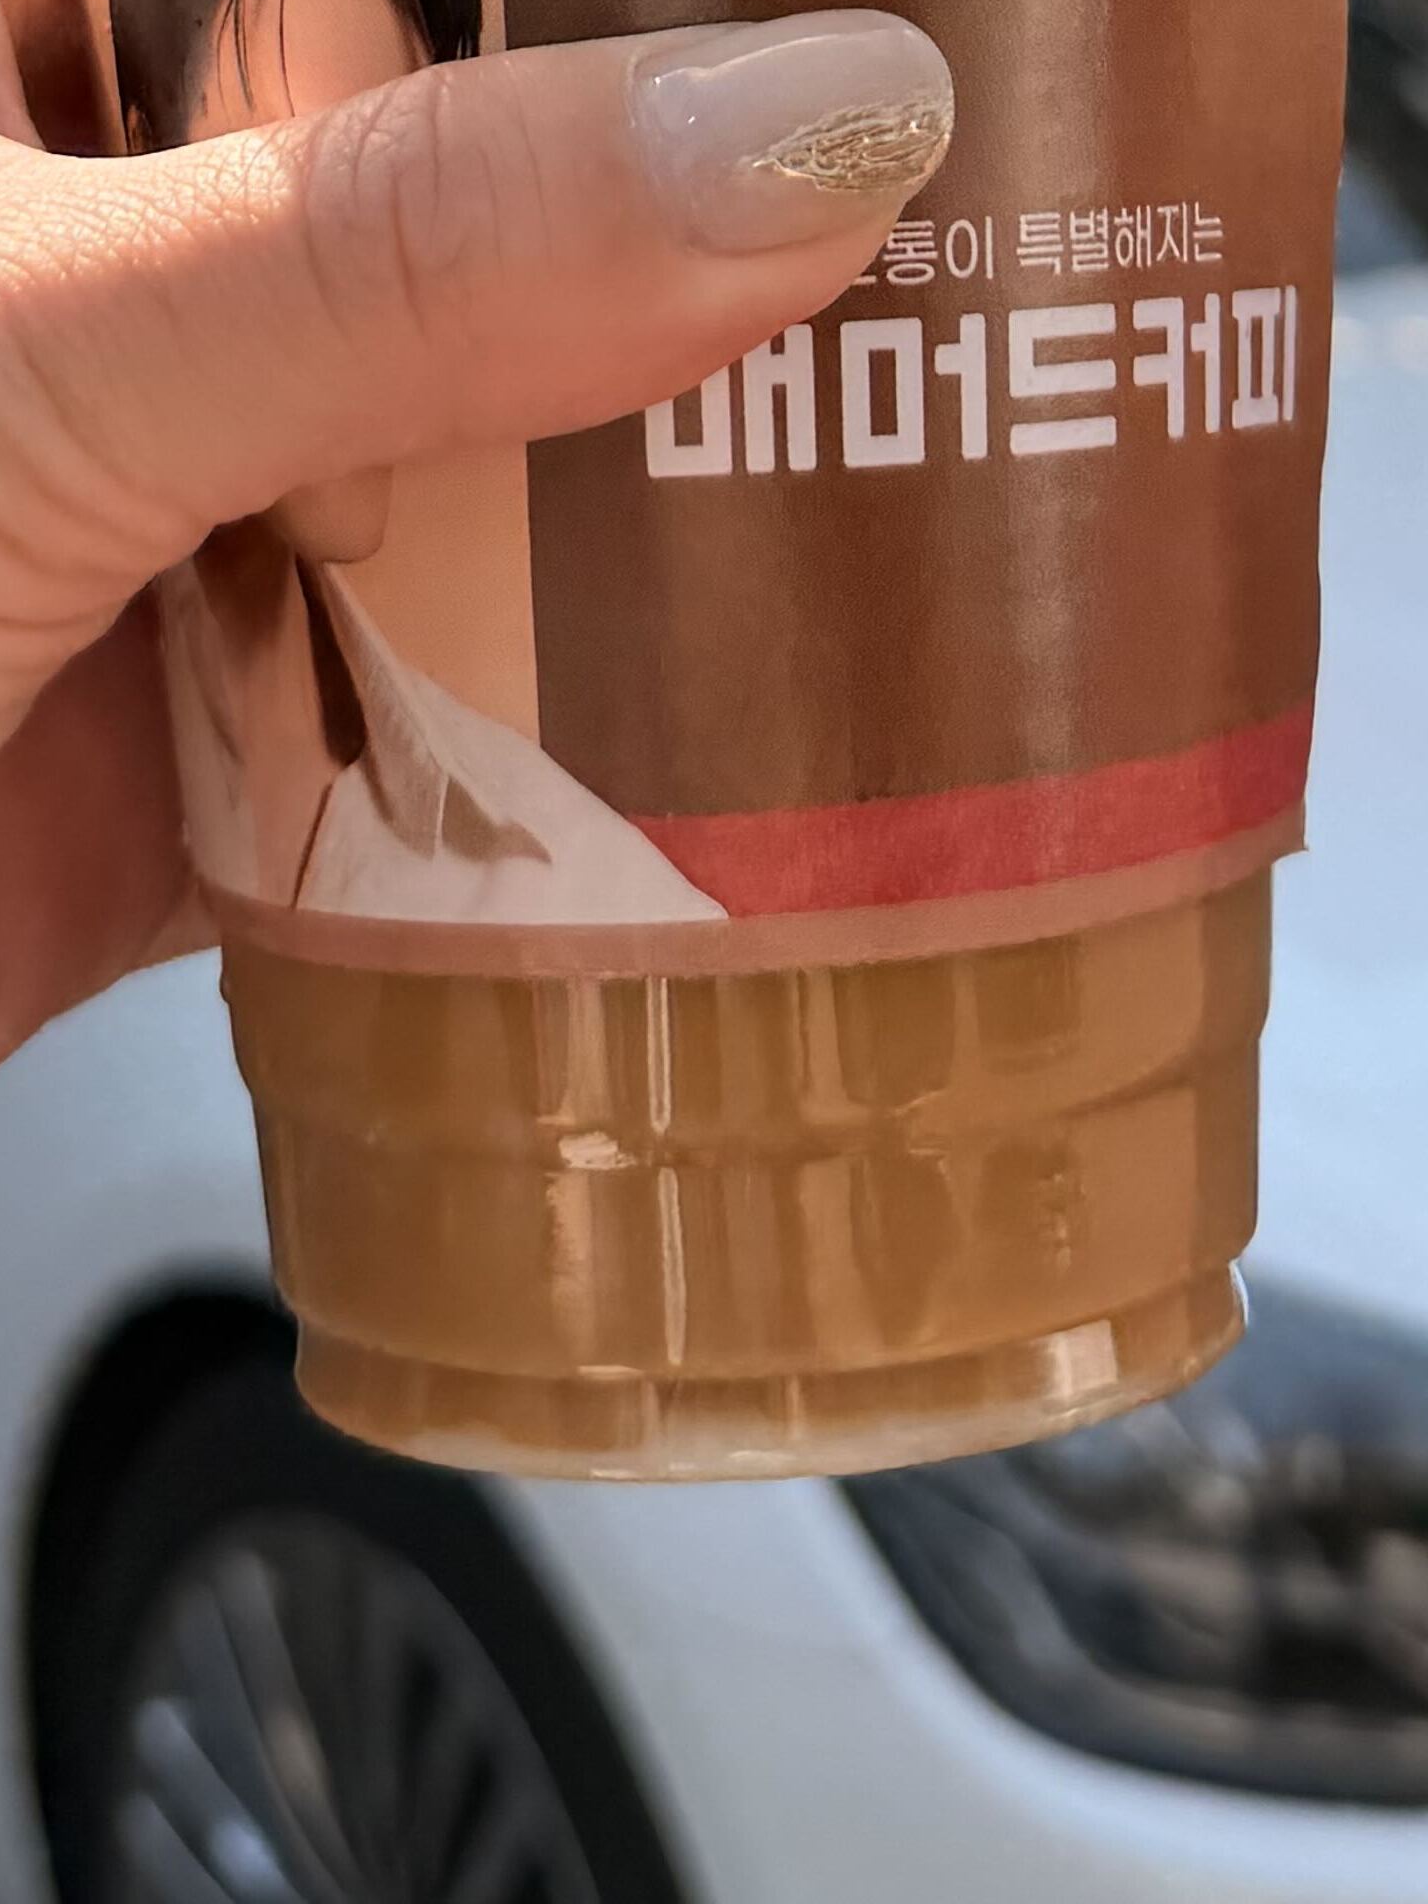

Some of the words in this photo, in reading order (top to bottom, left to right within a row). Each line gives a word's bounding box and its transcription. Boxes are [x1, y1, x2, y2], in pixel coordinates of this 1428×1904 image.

[852, 215, 994, 286] 통이
[1015, 200, 1224, 276] 특별해지는
[645, 284, 1298, 479] 매머드커피
